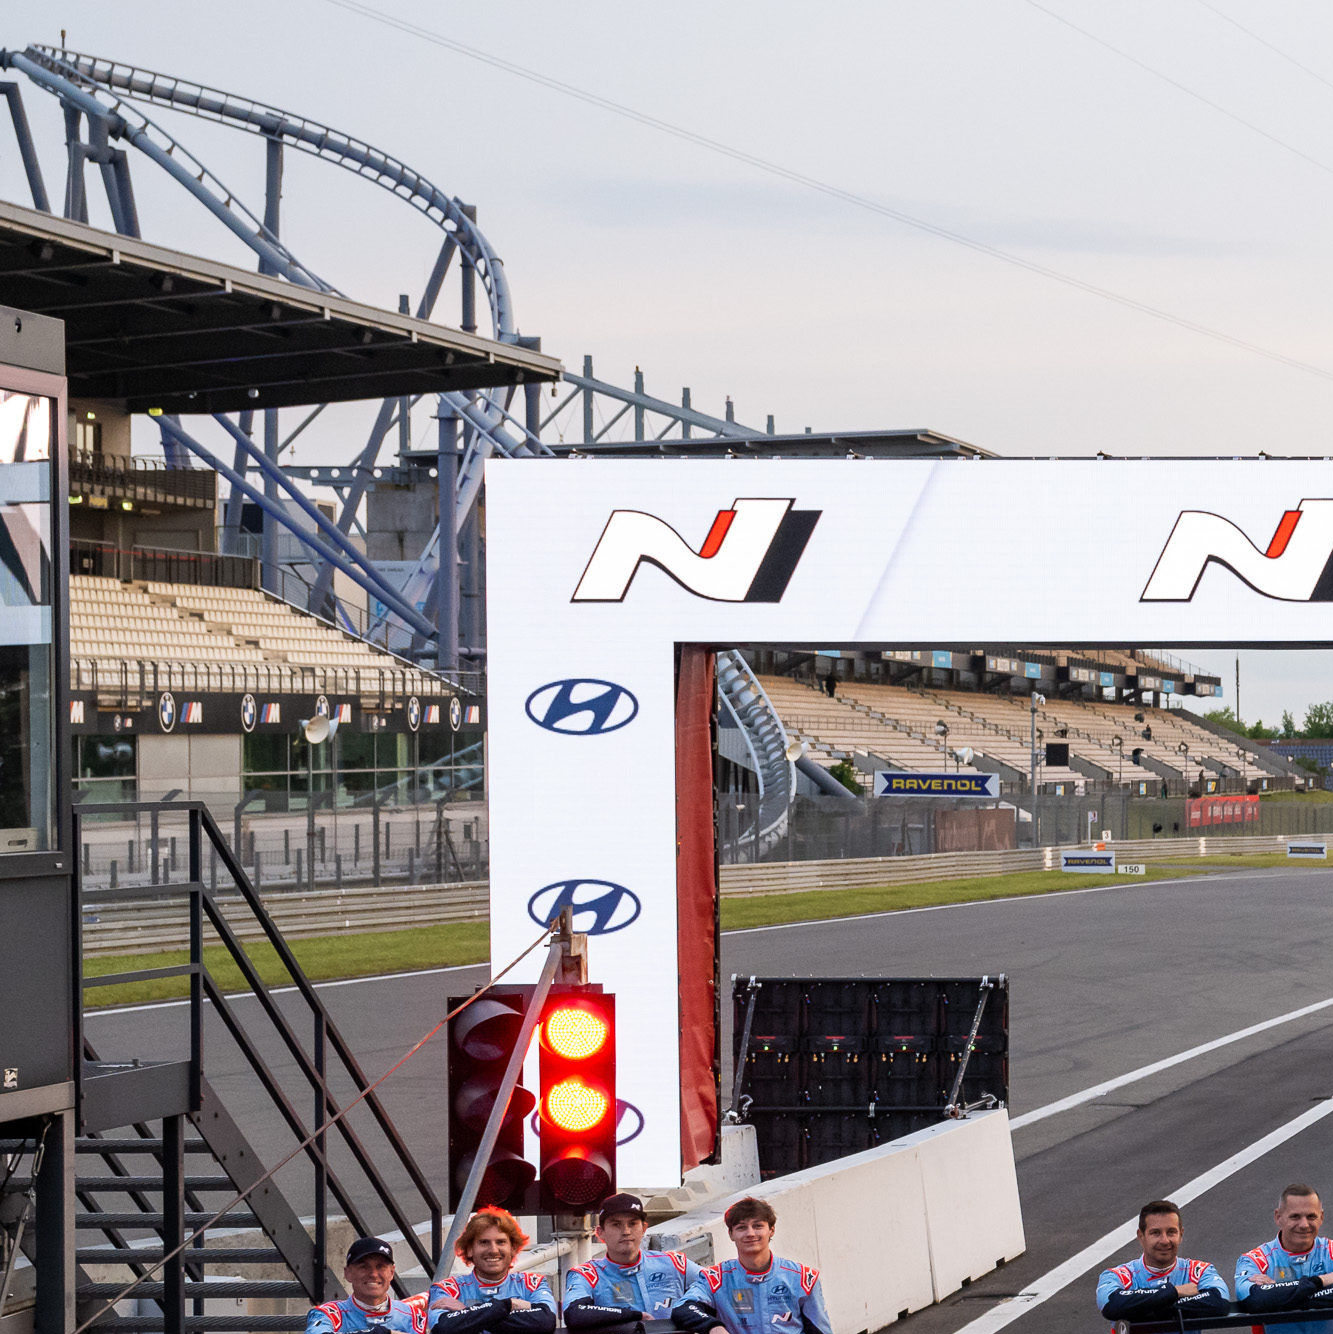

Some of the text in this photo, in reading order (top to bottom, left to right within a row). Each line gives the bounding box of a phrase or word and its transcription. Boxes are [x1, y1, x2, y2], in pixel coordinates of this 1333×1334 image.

[892, 778, 982, 792] RAVENOL
[1067, 857, 1109, 866] RAVENOL
[1123, 865, 1140, 874] 150
[586, 1304, 622, 1314] HYUNDAI
